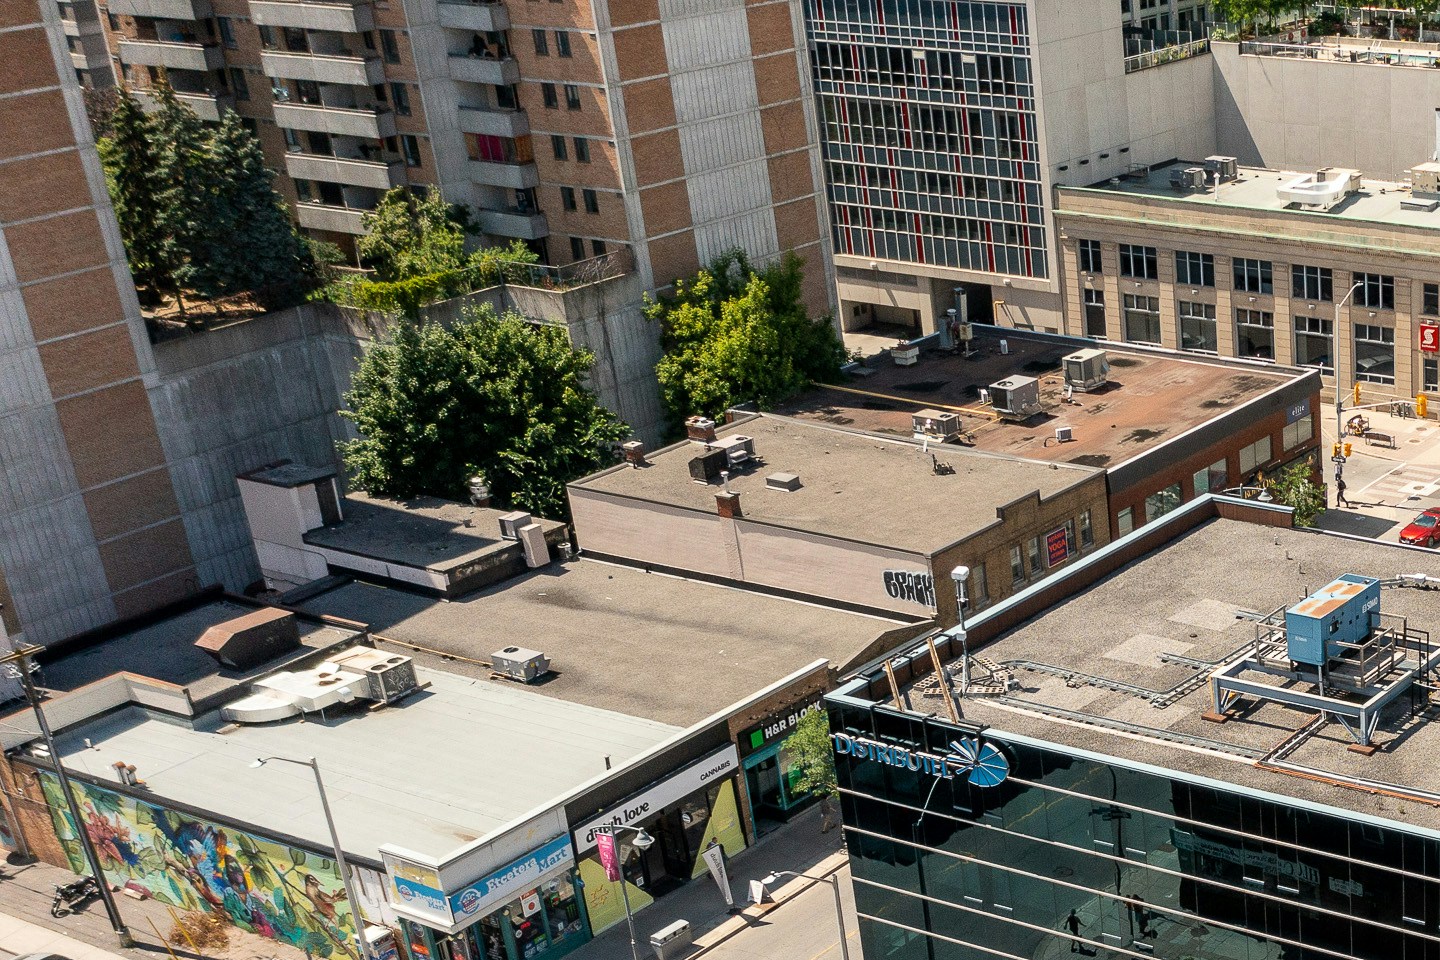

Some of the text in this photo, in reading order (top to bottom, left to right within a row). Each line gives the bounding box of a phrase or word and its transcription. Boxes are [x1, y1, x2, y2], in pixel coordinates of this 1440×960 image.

[1292, 404, 1305, 416] elite
[1049, 539, 1066, 552] YOGA
[765, 720, 787, 739] H&R
[834, 732, 953, 779] DISTRIBUTEL
[623, 802, 650, 823] love
[700, 760, 730, 781] CANNABIS
[486, 849, 567, 891] Etcetera Mart
